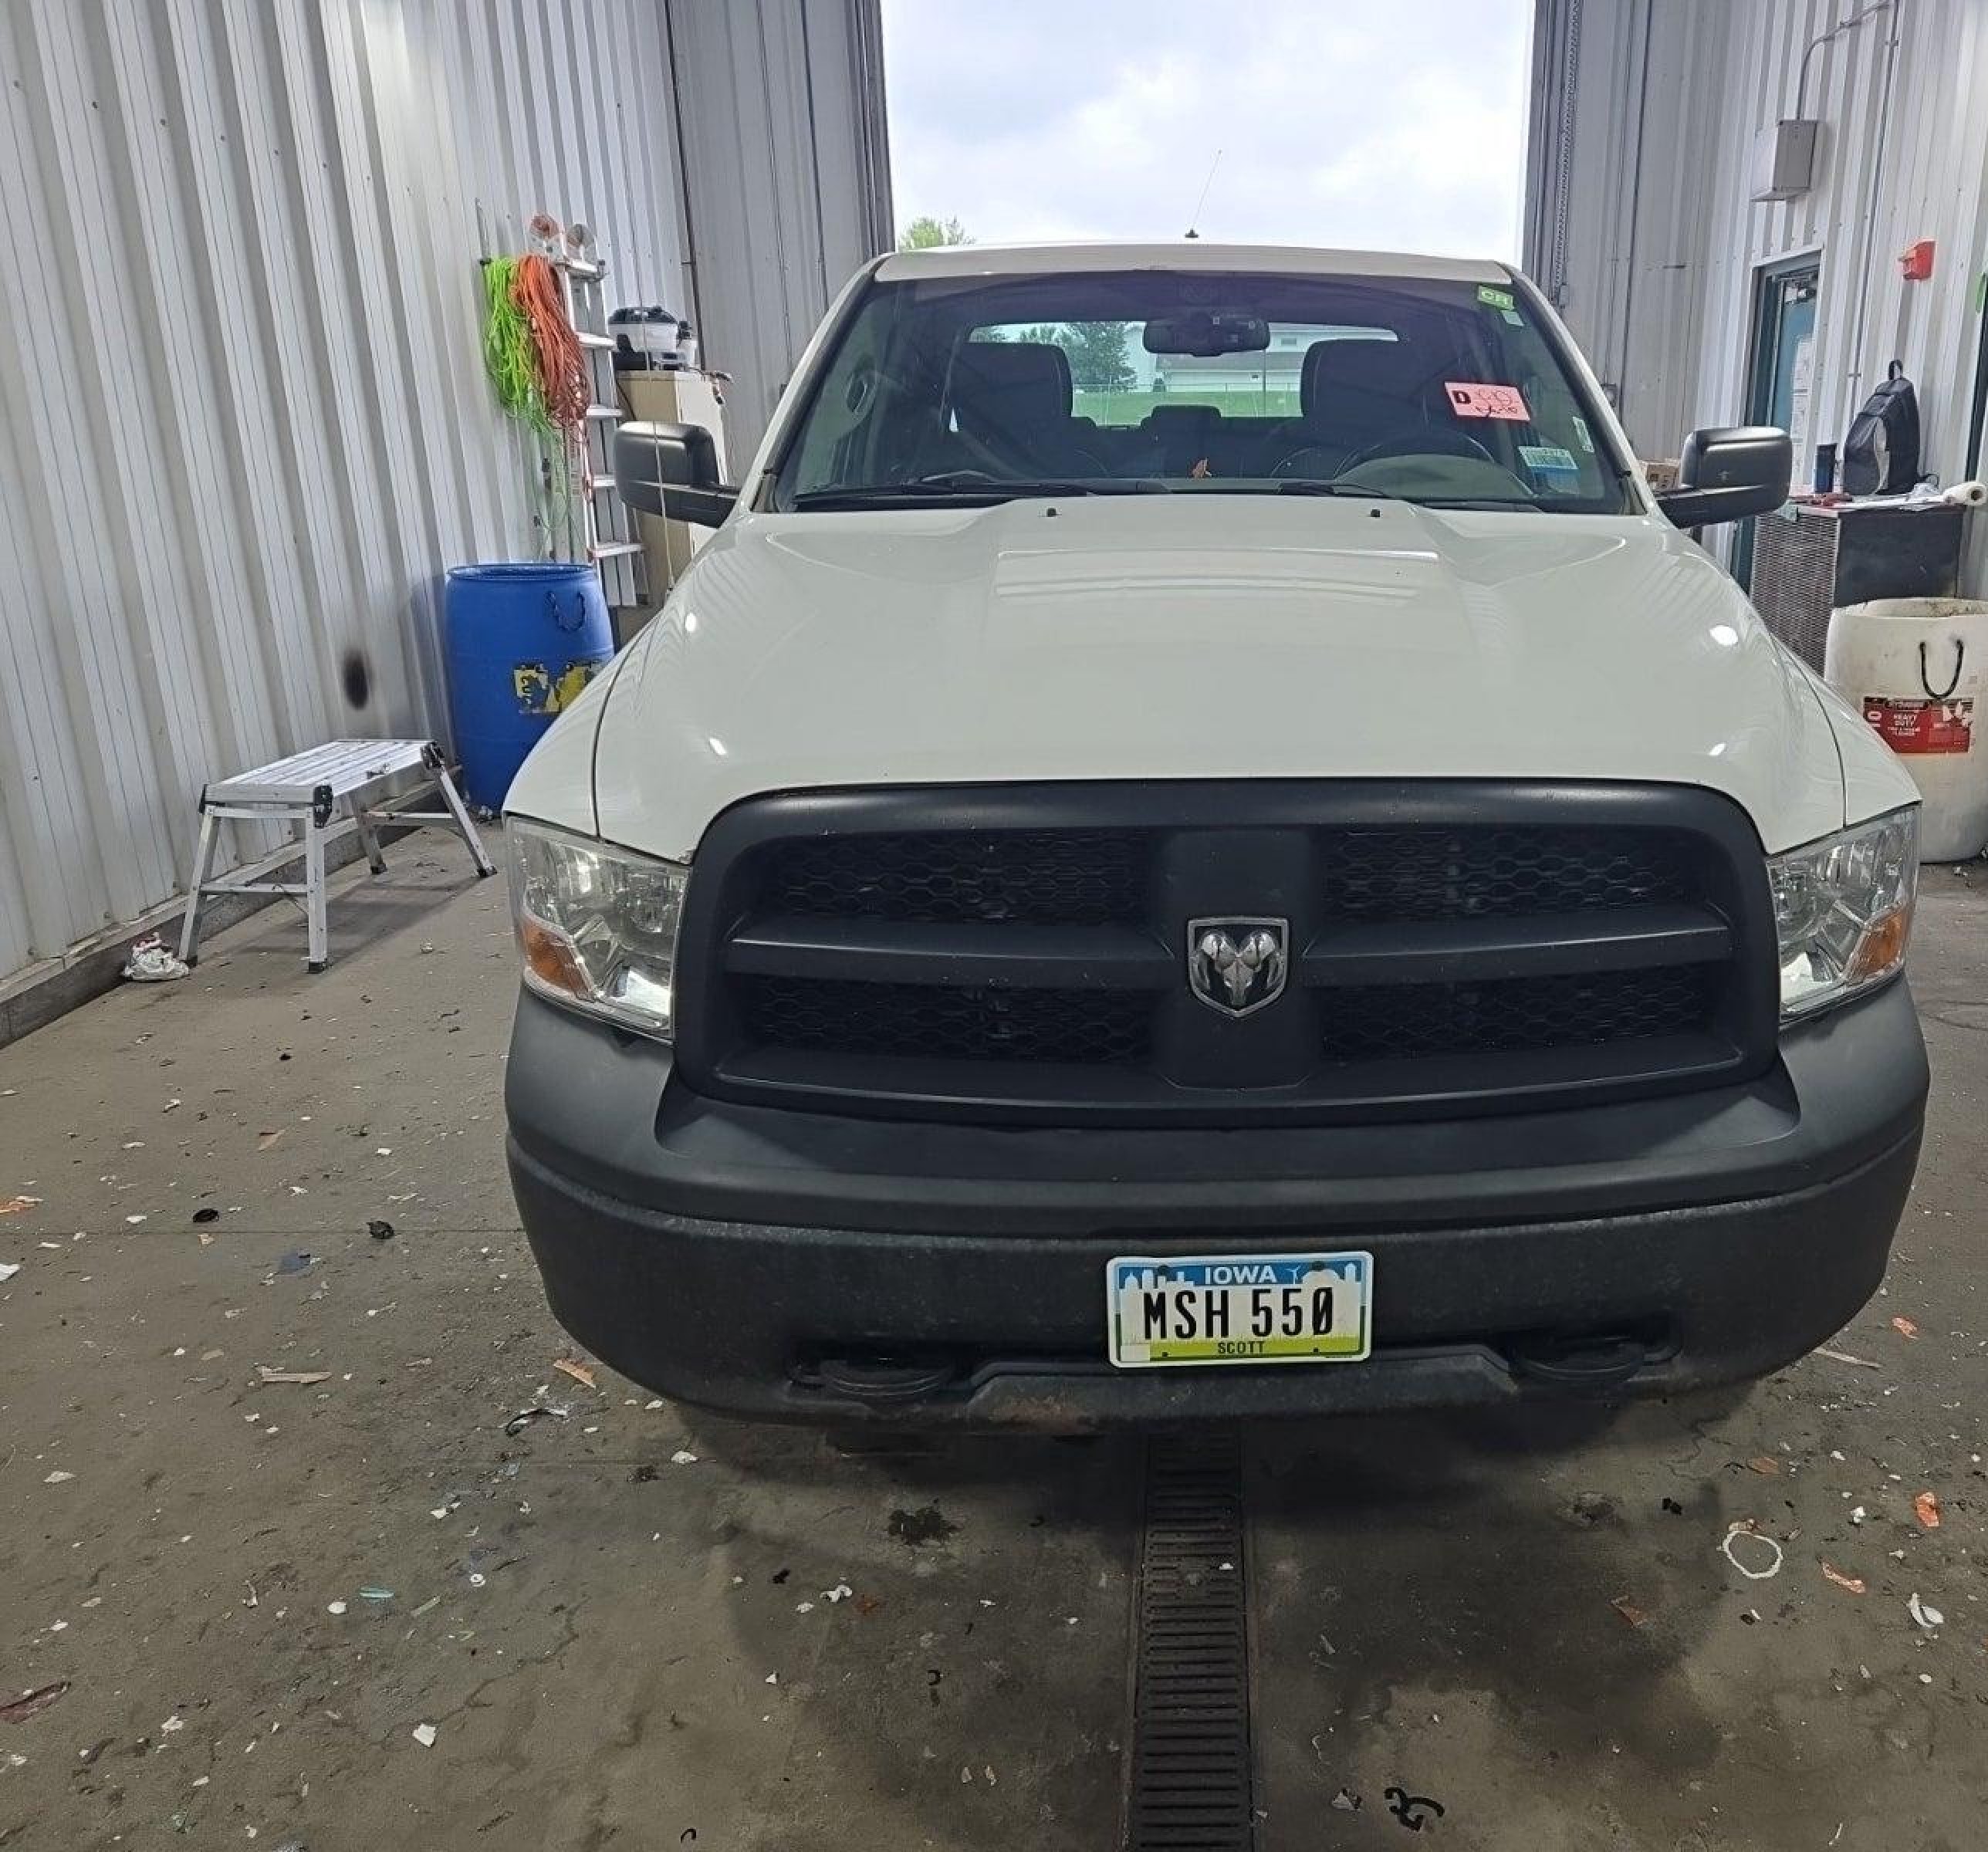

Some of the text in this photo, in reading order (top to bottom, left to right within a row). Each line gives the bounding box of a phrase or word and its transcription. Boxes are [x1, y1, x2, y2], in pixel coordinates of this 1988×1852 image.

[1452, 390, 1472, 405] D
[1205, 1265, 1276, 1285] IOWA
[1143, 1286, 1333, 1340] MSH 550
[1217, 1340, 1265, 1354] SCOTT
